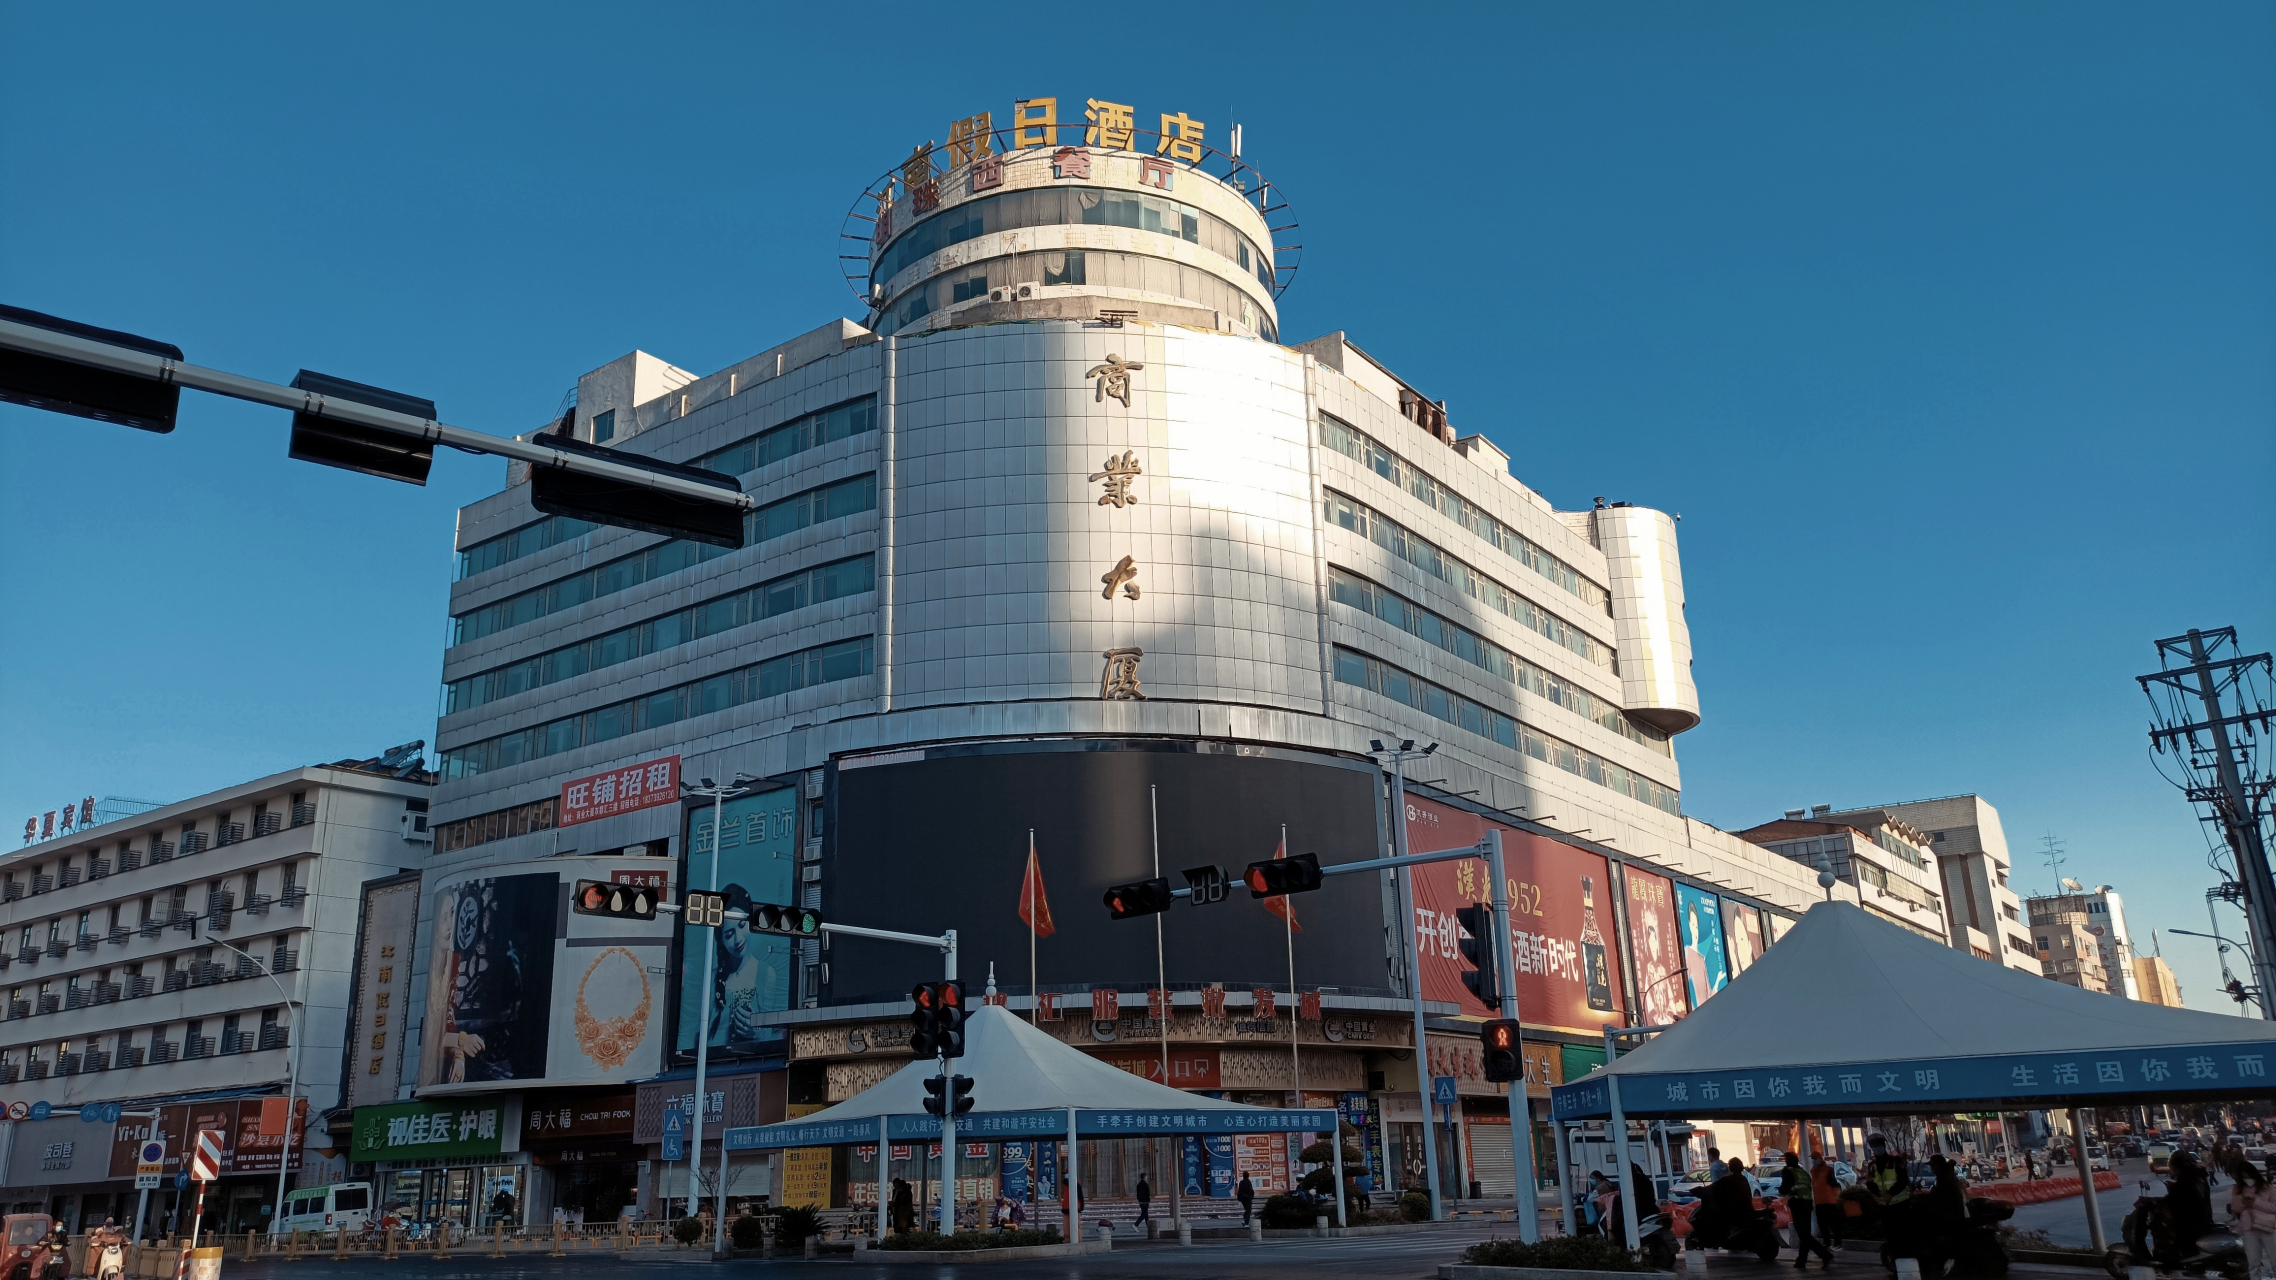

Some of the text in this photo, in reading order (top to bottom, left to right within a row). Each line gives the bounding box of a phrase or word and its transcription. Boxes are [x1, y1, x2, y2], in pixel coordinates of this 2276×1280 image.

[566, 762, 671, 809] 旺铺招租
[23, 796, 95, 844] 华夏宾馆
[695, 807, 795, 854] 金兰首饰
[1508, 879, 1543, 917] 952
[369, 945, 395, 1075] 江南假日酒店
[1345, 1021, 1376, 1033] 中国黄金
[1666, 1054, 2266, 1102] 城市因你我而文明 生活因你我而
[529, 1109, 571, 1130] 周大福
[580, 1110, 631, 1121] CHOW TAI FOOK
[901, 1116, 1056, 1133] 人人践行文交通 共建和谐平安社会
[1097, 1115, 1322, 1128] 手牵手创建文明城市 心连心打造美丽家园
[733, 1134, 753, 1145] 文明出行
[823, 1126, 845, 1139] 文明交通
[43, 1142, 75, 1160] 波司登
[561, 1151, 584, 1161] 周大福
[1002, 1146, 1023, 1159] 399
